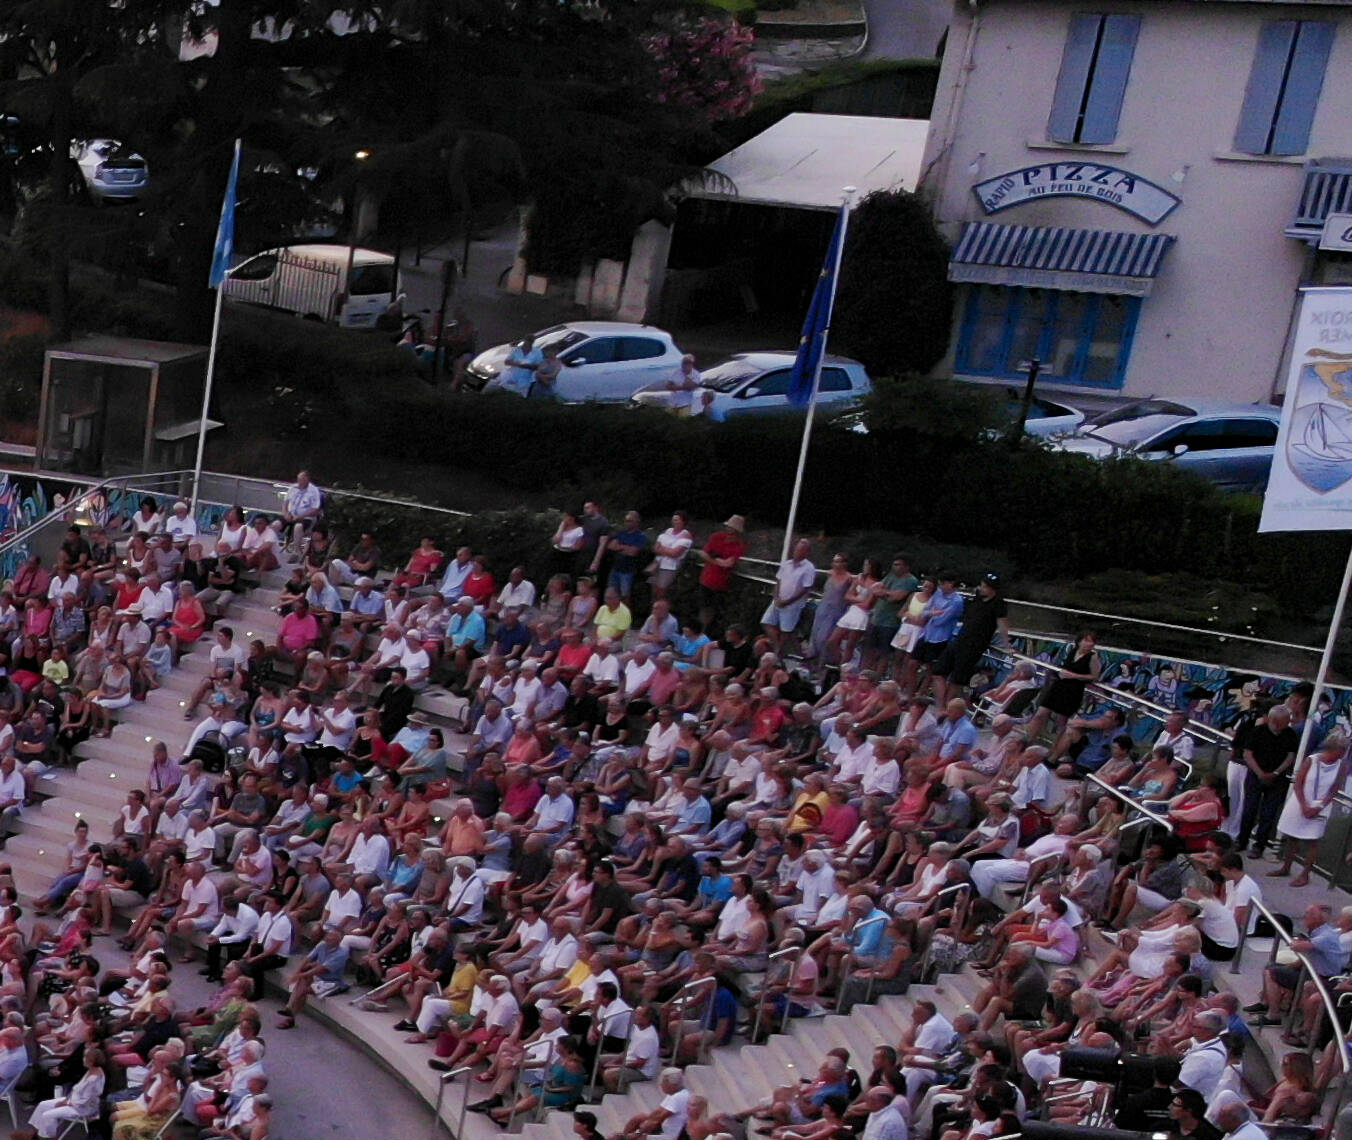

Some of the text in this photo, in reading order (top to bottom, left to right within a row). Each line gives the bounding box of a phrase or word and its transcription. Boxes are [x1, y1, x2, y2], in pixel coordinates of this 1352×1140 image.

[985, 178, 1015, 209] RAPID
[1022, 165, 1135, 194] PIZZA
[1028, 186, 1045, 196] AU
[1050, 183, 1073, 192] FEU
[1077, 184, 1093, 193] DE
